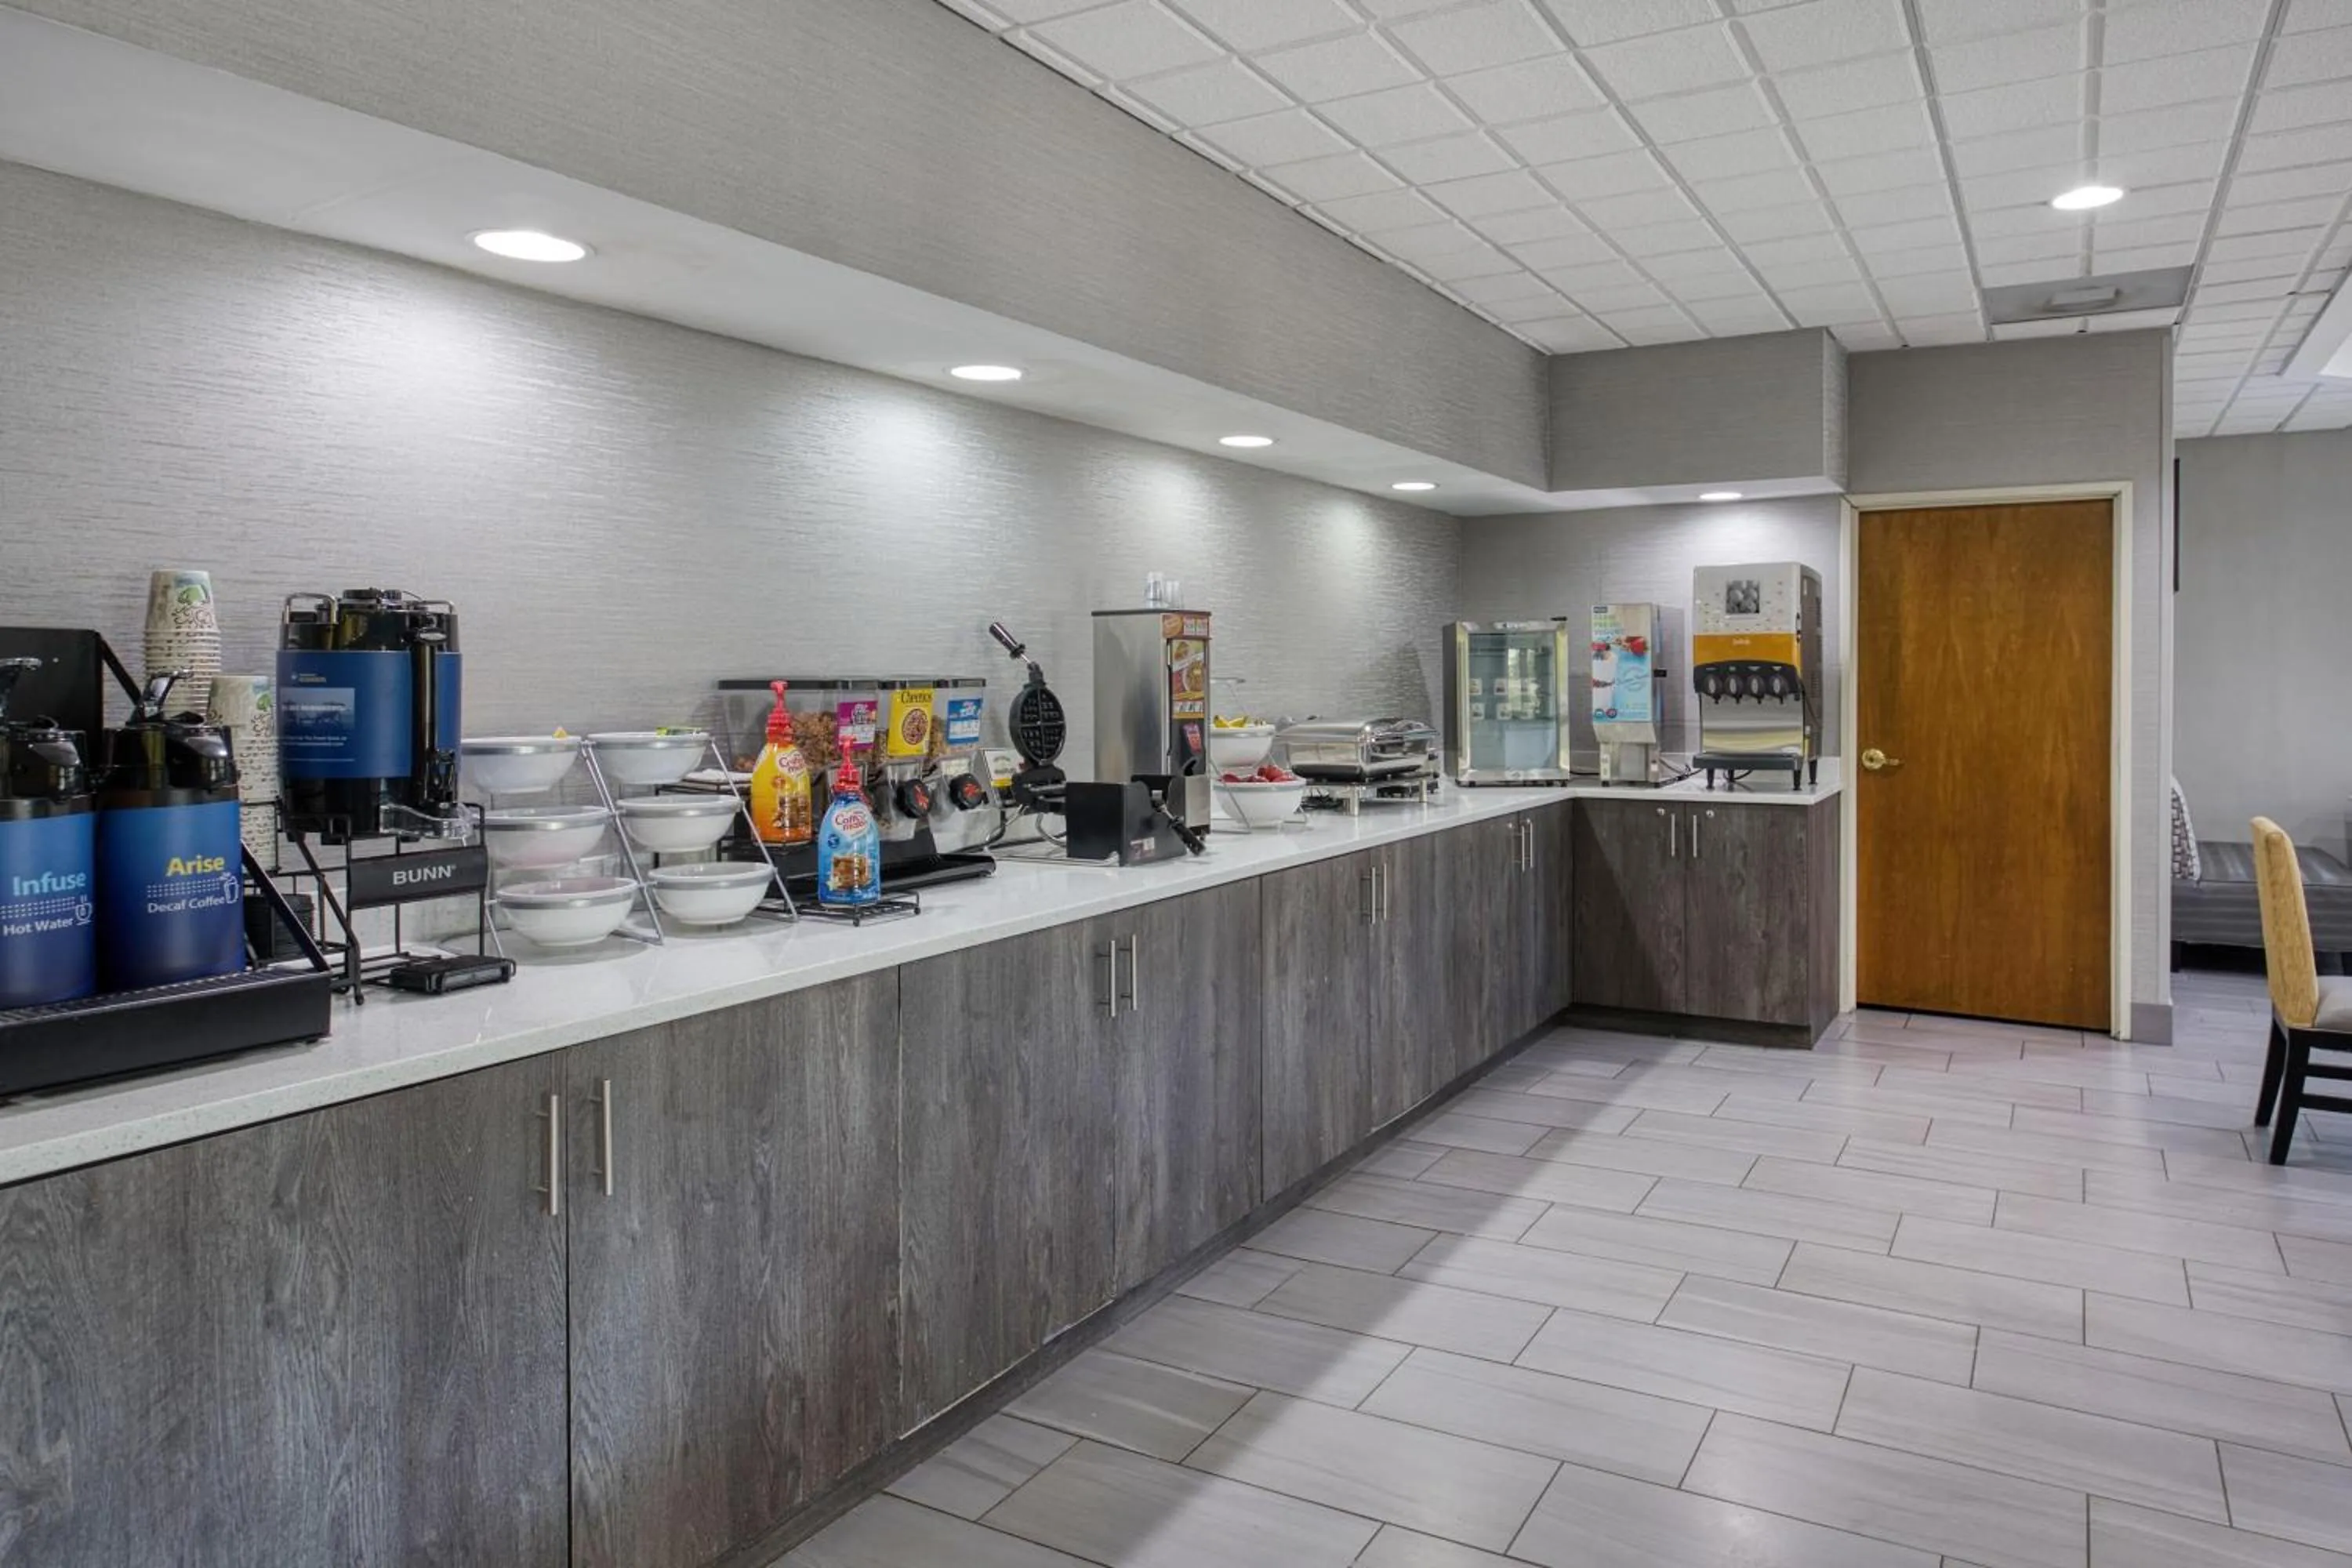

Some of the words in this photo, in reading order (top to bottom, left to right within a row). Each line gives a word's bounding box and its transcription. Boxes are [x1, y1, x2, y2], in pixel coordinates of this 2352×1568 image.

[166, 854, 224, 877] Arise
[393, 865, 452, 885] BUNN
[13, 871, 86, 896] Infuse
[147, 898, 186, 913] Decaf
[188, 895, 225, 909] Coffee
[3, 922, 32, 936] Hot
[34, 916, 74, 932] Water
